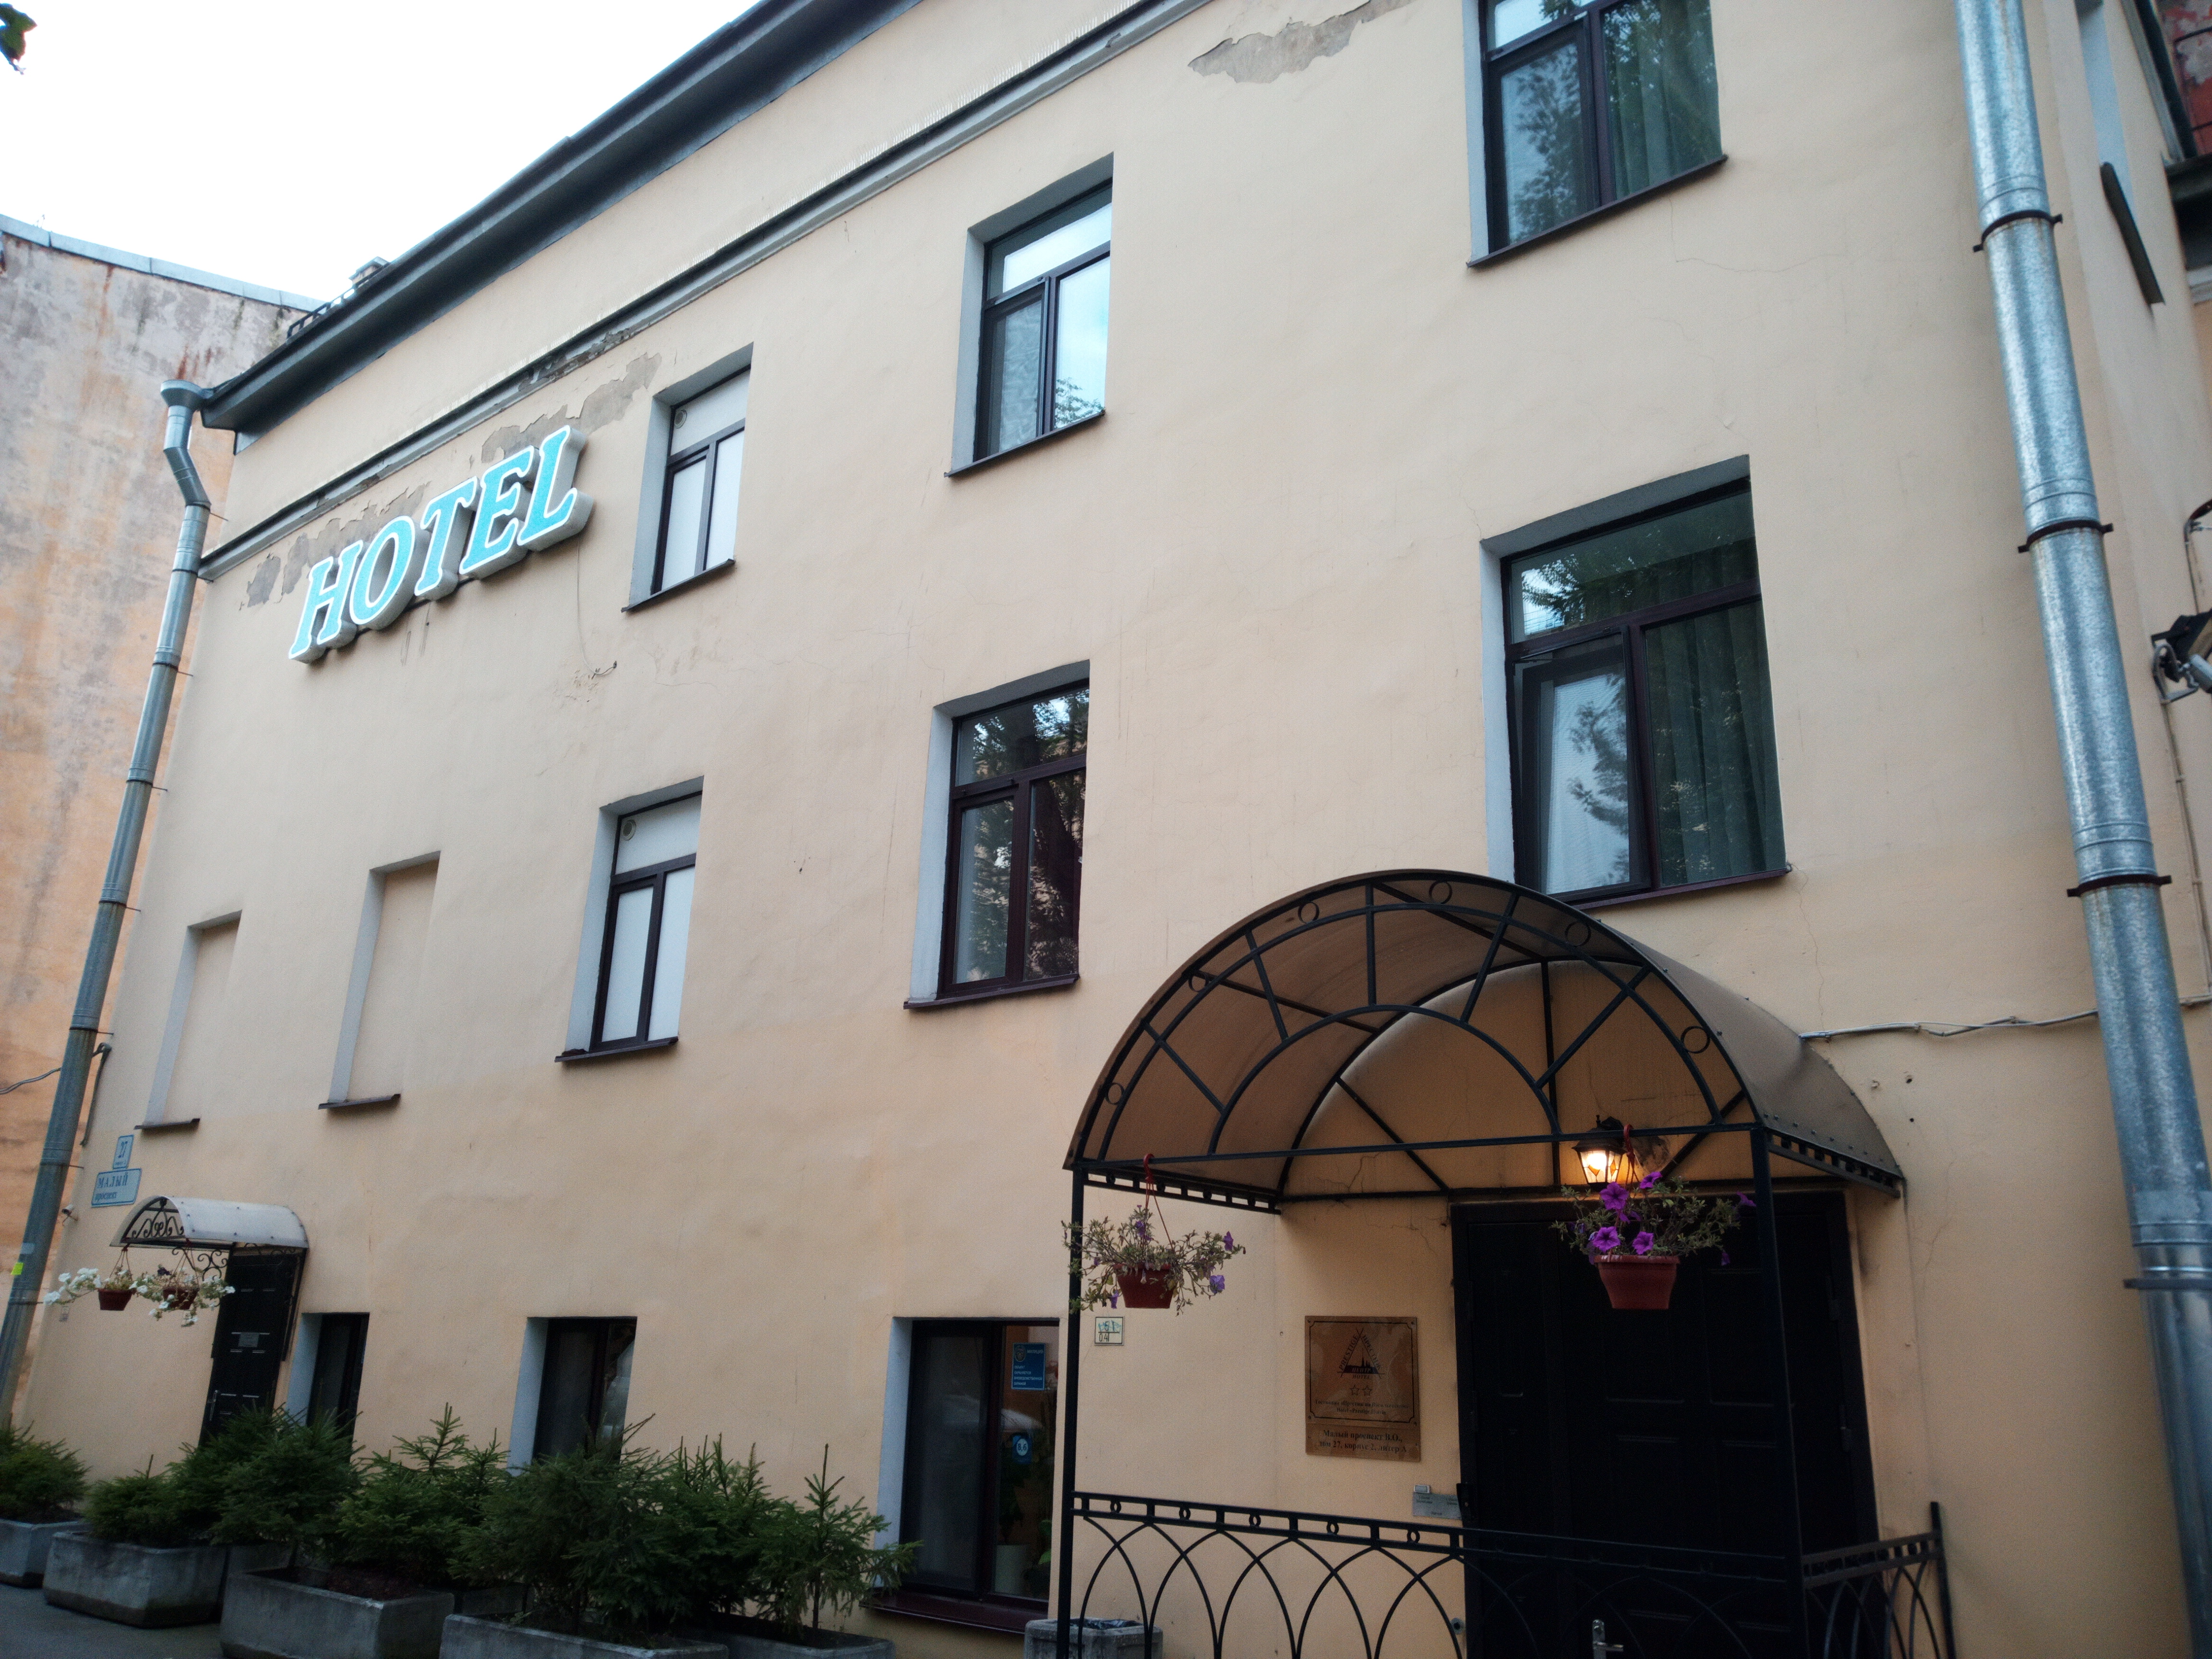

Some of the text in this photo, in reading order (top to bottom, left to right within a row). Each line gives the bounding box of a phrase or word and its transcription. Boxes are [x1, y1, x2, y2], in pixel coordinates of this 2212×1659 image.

[289, 425, 583, 661] HOTEL
[118, 1141, 128, 1158] 27
[97, 1172, 128, 1189] МАЛЫЙ
[1339, 1334, 1358, 1370] PRESTIGE
[1323, 1430, 1348, 1438] Малый
[1344, 1443, 1368, 1451] корпус
